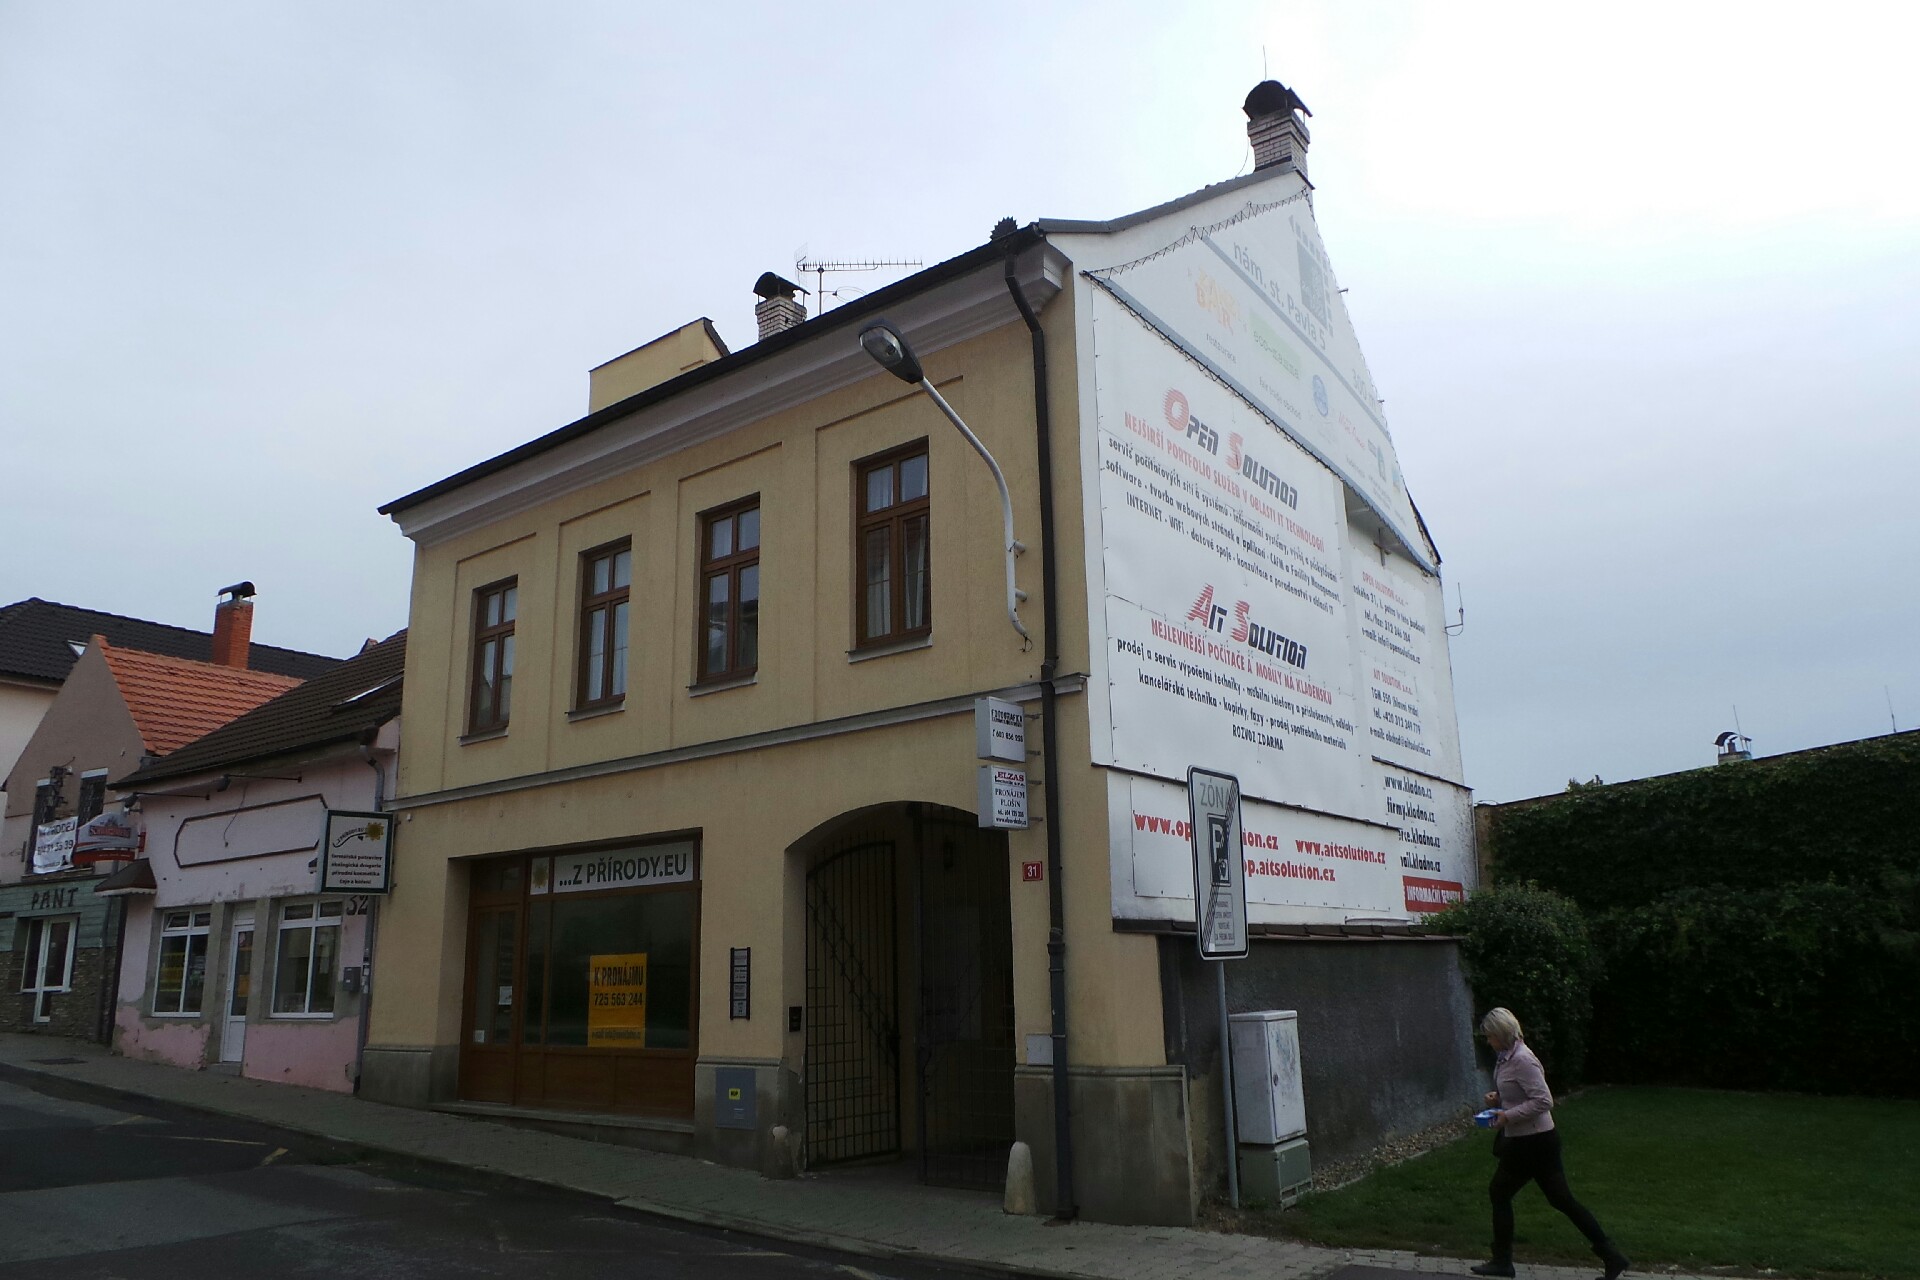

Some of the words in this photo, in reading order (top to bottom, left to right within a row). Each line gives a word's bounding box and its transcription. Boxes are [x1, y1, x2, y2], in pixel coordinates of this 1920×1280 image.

[1234, 242, 1267, 288] nám.
[1269, 280, 1285, 308] st.
[1287, 293, 1317, 342] Pavla
[1109, 437, 1134, 460] servis
[1167, 438, 1211, 480] PORTFOLIO
[1213, 469, 1240, 499] SLUŽEB
[1242, 488, 1248, 504] V
[1249, 493, 1276, 523] OBLASTI
[1277, 511, 1284, 527] IT
[1106, 460, 1142, 488] software
[1149, 483, 1174, 507] tvorba
[1176, 502, 1210, 528] webových
[1211, 520, 1235, 542] stránek
[1126, 491, 1163, 522] INTERNET
[1191, 527, 1214, 551] datové
[1216, 544, 1232, 562] spoje
[1117, 638, 1145, 661] prodej
[1147, 649, 1152, 660] a
[1154, 653, 1177, 679] servis
[1179, 660, 1212, 682] výpočetní
[1214, 671, 1241, 697] techniky
[1255, 661, 1283, 686] MOBILY
[1284, 673, 1295, 691] NA
[1296, 677, 1332, 705] KLADENSKU
[1138, 667, 1184, 697] kancelářská
[1187, 686, 1217, 708] technika
[1223, 696, 1249, 720] kopírky,
[1250, 707, 1264, 726] faxy
[1270, 717, 1290, 735] prodej
[1232, 724, 1256, 745] ROZVOZ
[1257, 732, 1285, 752] ZDARMA
[997, 771, 1025, 782] ELZAS
[1384, 775, 1432, 800] www.kladno.cz
[995, 786, 1025, 799] PRONÁJEM
[1000, 796, 1021, 808] PLOŠIN
[1386, 796, 1435, 823] firmy.kladno.cz
[1296, 838, 1386, 864] www.aitsolution.cz
[586, 853, 687, 883] PŘÍRODY.EU
[1027, 865, 1038, 878] 31
[31, 887, 79, 910] PANT
[594, 966, 600, 987] K
[602, 962, 644, 987] PRONÁJMU
[594, 993, 609, 1006] 725
[611, 992, 626, 1006] 563
[628, 992, 643, 1006] 244
